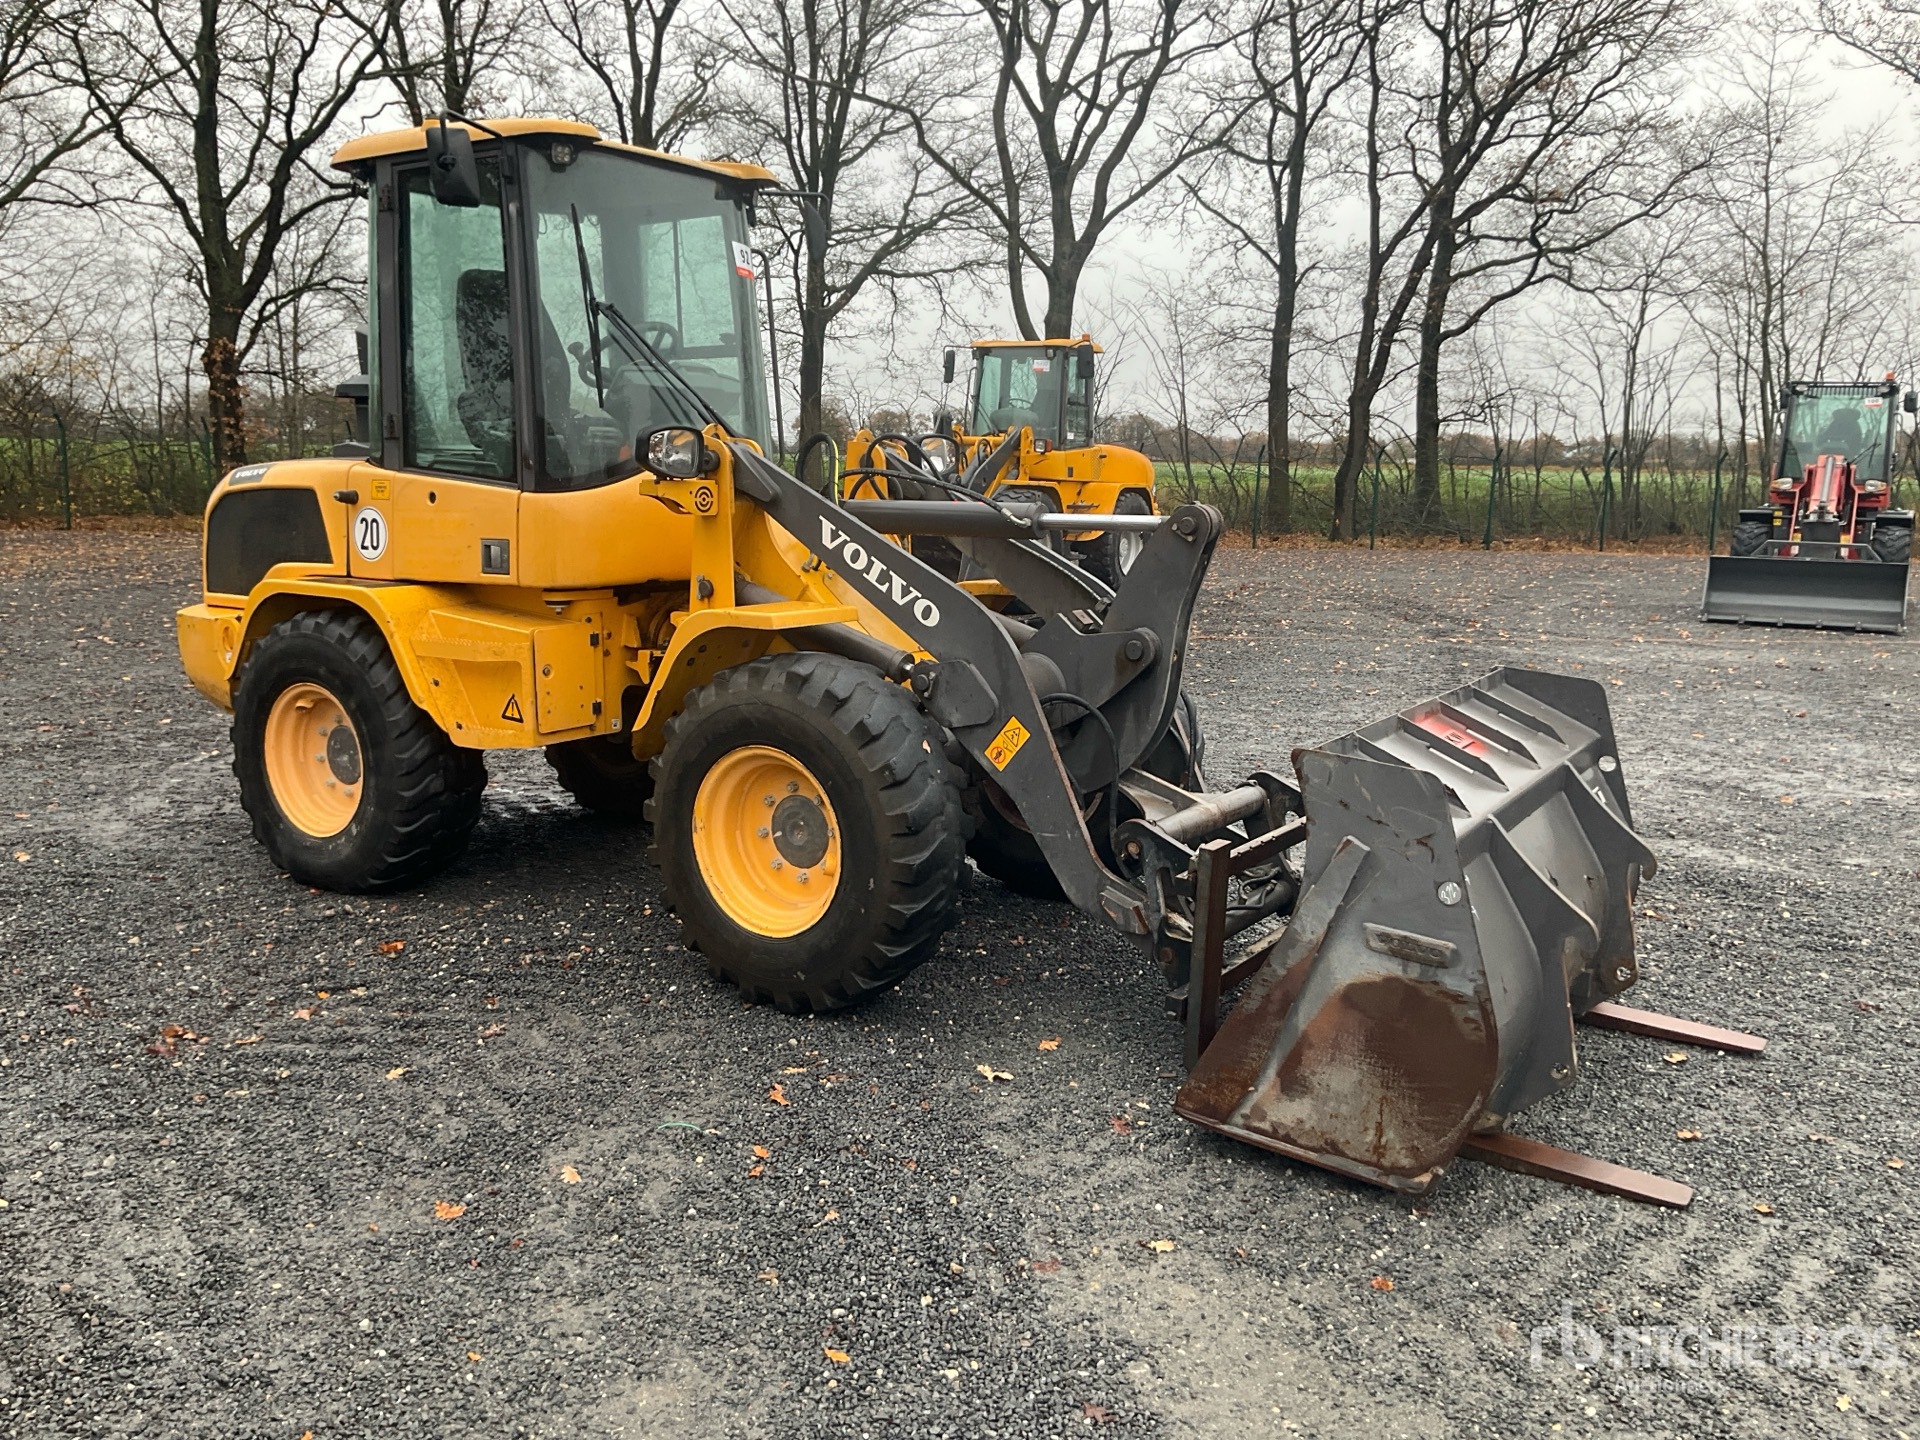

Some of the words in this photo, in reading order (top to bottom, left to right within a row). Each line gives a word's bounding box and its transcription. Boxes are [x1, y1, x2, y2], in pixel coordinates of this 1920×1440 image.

[235, 467, 267, 479] VOLVO
[360, 517, 380, 551] 20
[819, 514, 940, 627] VOLVO
